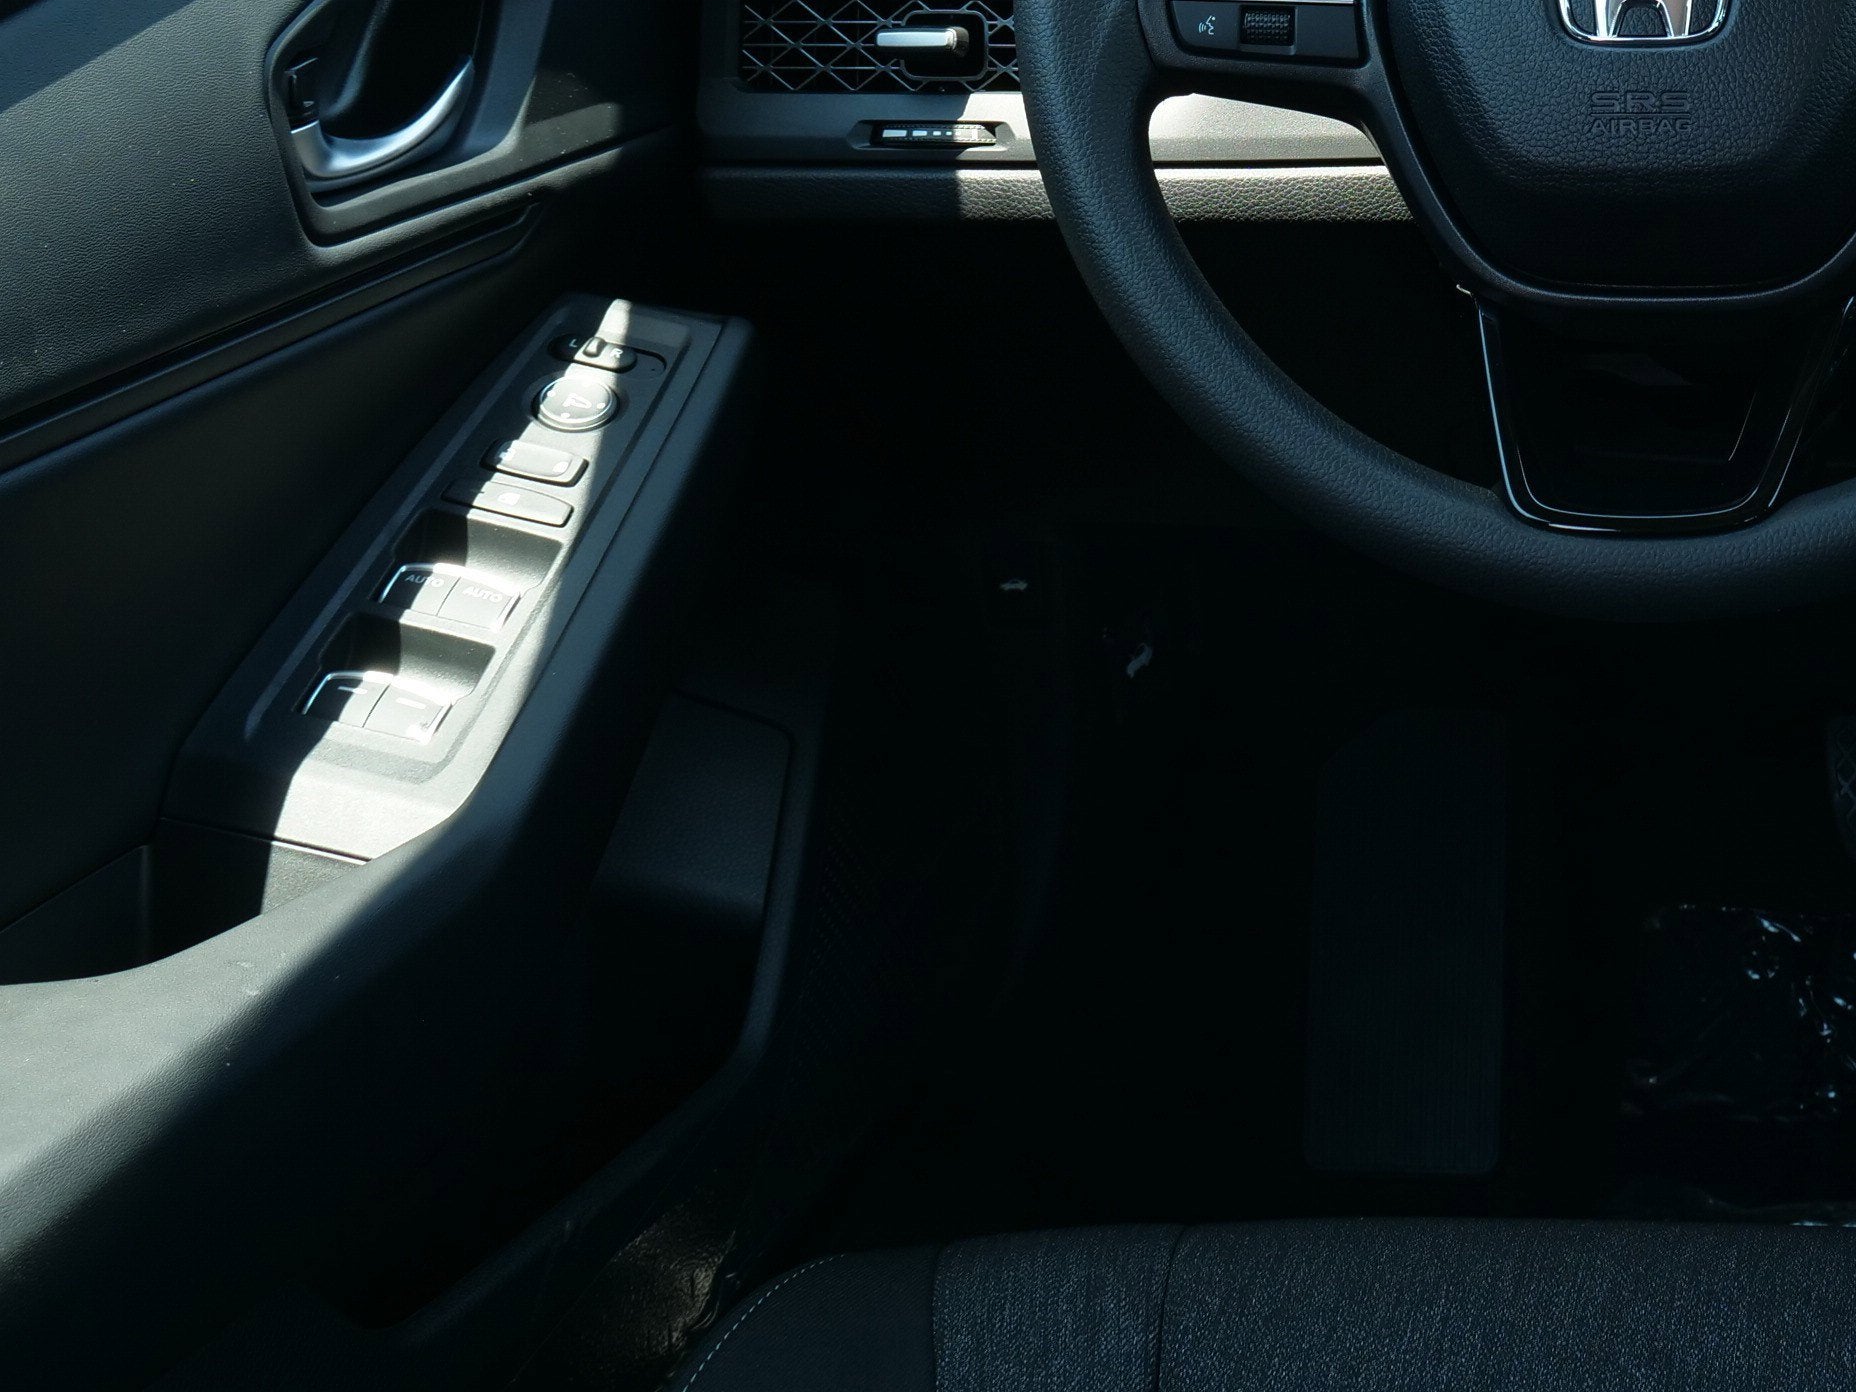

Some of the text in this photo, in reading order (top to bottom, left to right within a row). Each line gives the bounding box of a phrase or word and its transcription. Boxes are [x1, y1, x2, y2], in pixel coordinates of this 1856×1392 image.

[1590, 90, 1690, 112] SRS
[1590, 118, 1692, 134] AIRBAG
[569, 338, 578, 348] L
[405, 574, 444, 588] AUTO
[463, 586, 503, 603] AUTO
